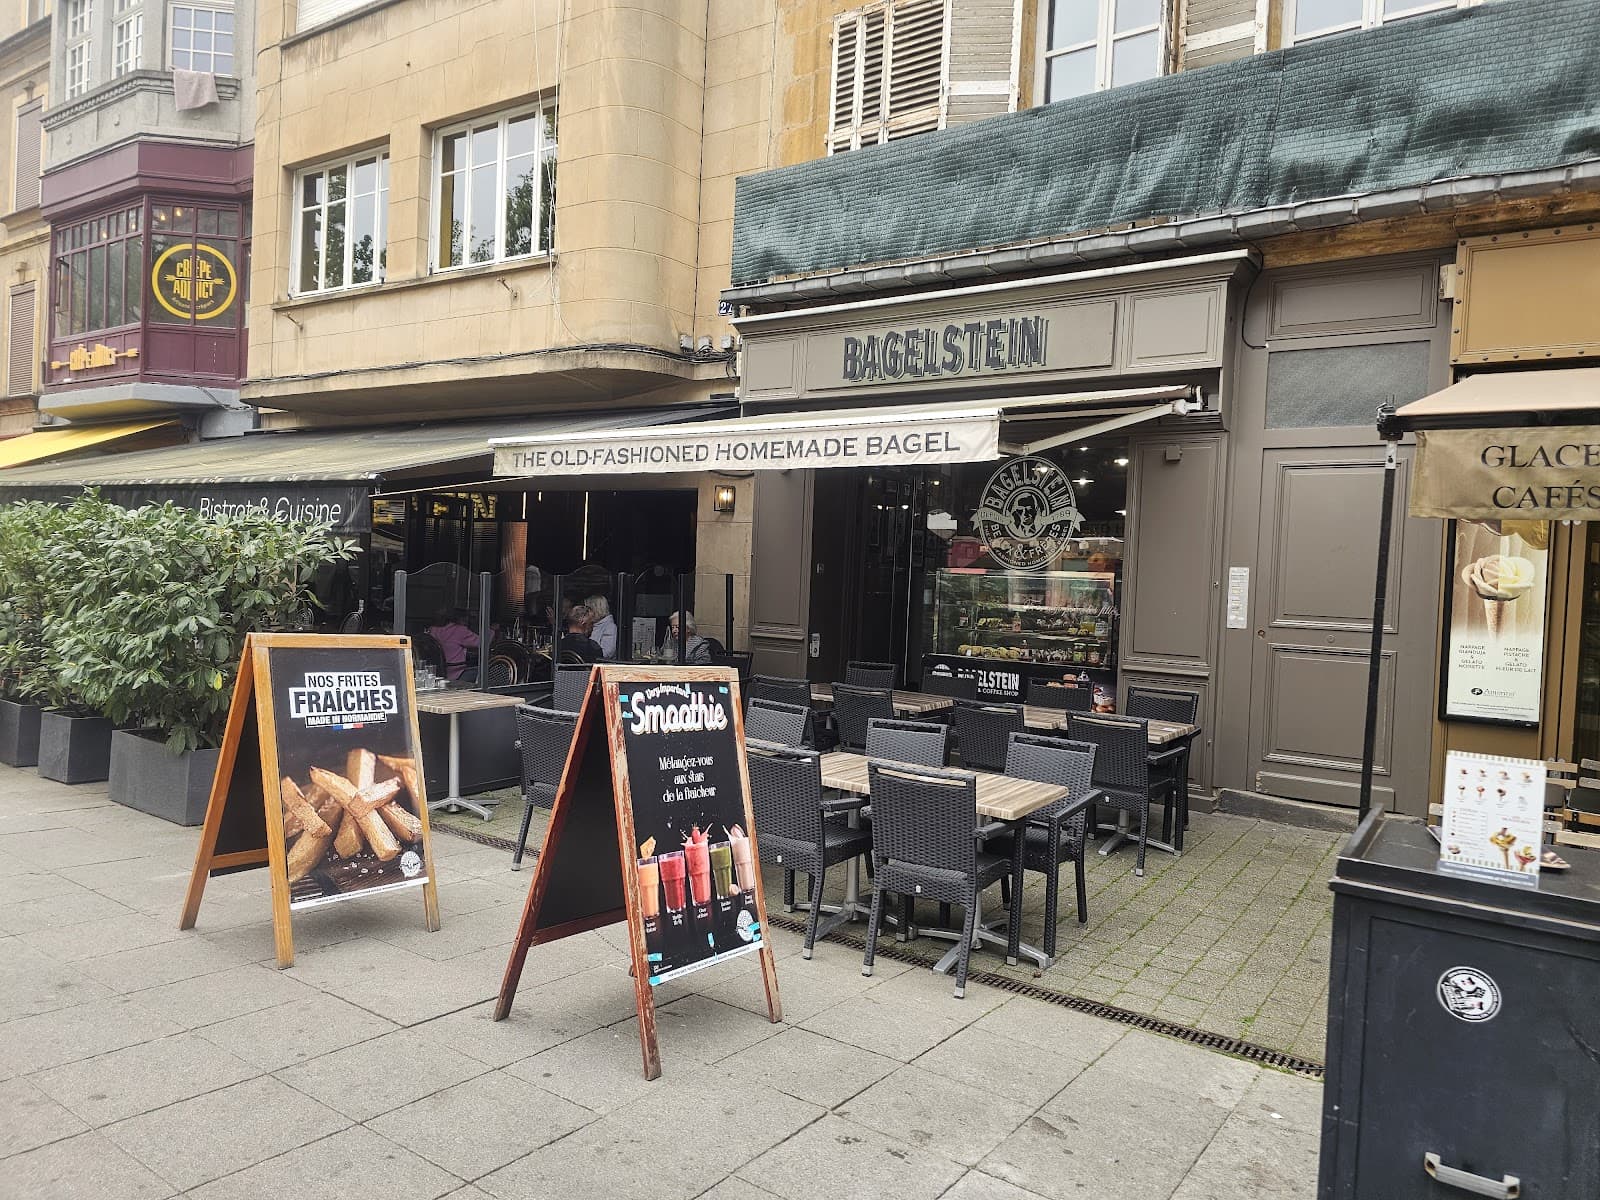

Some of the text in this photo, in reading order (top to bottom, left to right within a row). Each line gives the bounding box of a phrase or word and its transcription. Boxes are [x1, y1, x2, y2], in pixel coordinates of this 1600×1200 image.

[842, 316, 1050, 382] BAGELSTEIN
[512, 451, 547, 468] THE
[716, 437, 858, 461] HOMEMADE
[866, 431, 961, 456] BAGEL
[984, 461, 1071, 510] BAGELSTEIN
[1492, 479, 1600, 509] CAFÉS
[200, 497, 252, 521] Bistrot
[275, 497, 342, 522] Cuisine
[308, 674, 379, 688] NOS FRITES
[293, 687, 395, 714] FRAÎCHES
[307, 712, 386, 726] MADE IN NORMANDIE
[674, 774, 688, 785] aux
[663, 789, 675, 803] de
[675, 787, 684, 802] la
